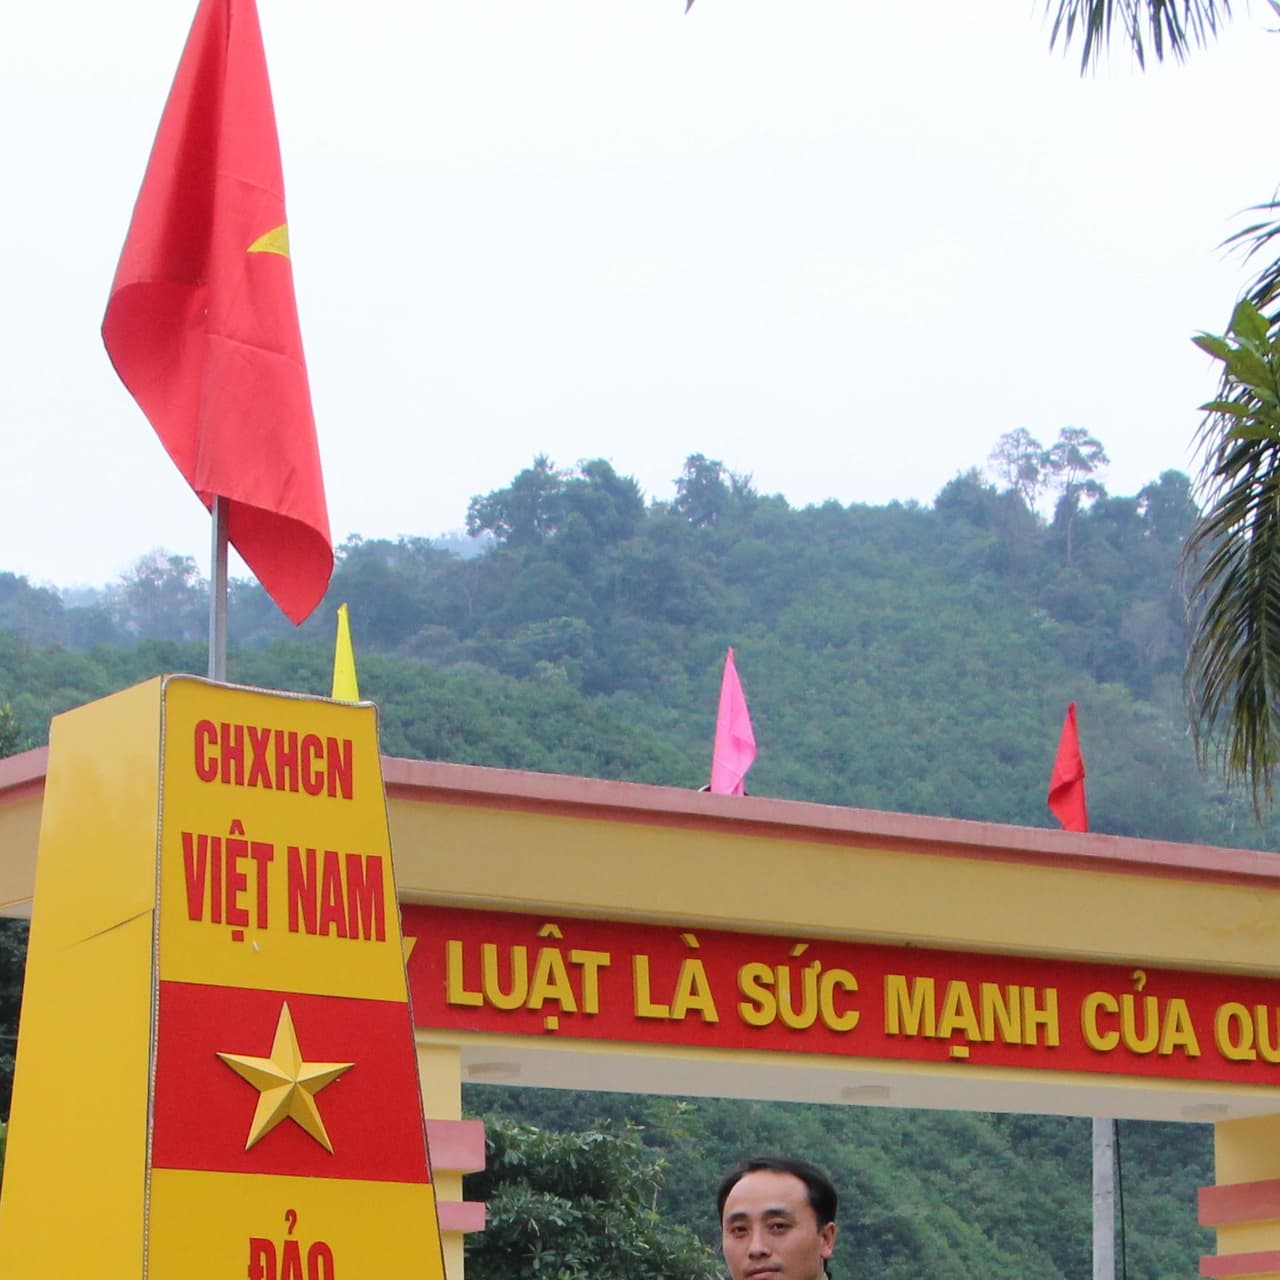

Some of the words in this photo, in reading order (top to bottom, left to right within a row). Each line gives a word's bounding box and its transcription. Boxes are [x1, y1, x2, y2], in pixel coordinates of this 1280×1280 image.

[194, 719, 353, 800] CHXHCN
[181, 819, 274, 942] VIỆT
[287, 846, 386, 942] NAM
[445, 923, 611, 1031] LUẬT
[632, 933, 719, 1023] LÀ
[737, 944, 860, 1032] SỨC
[883, 973, 1060, 1058] MẠNH
[1081, 969, 1201, 1057] CỦA
